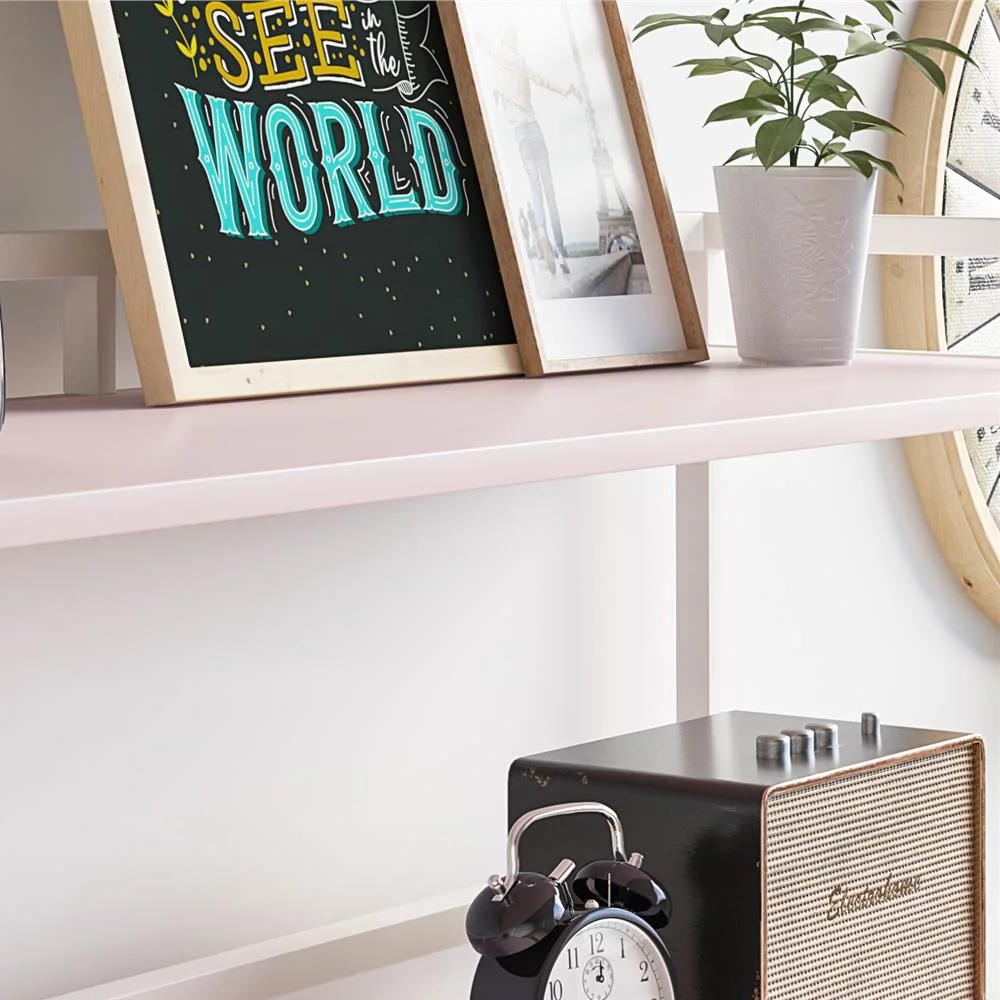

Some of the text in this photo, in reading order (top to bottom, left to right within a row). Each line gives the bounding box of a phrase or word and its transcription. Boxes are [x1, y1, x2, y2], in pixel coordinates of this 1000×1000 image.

[361, 7, 382, 31] in
[204, 0, 366, 92] SEE
[366, 31, 401, 77] the
[174, 82, 463, 240] WORLD
[590, 932, 604, 955] 12
[619, 937, 626, 959] 1
[567, 947, 579, 970] 11
[639, 960, 649, 982] 2
